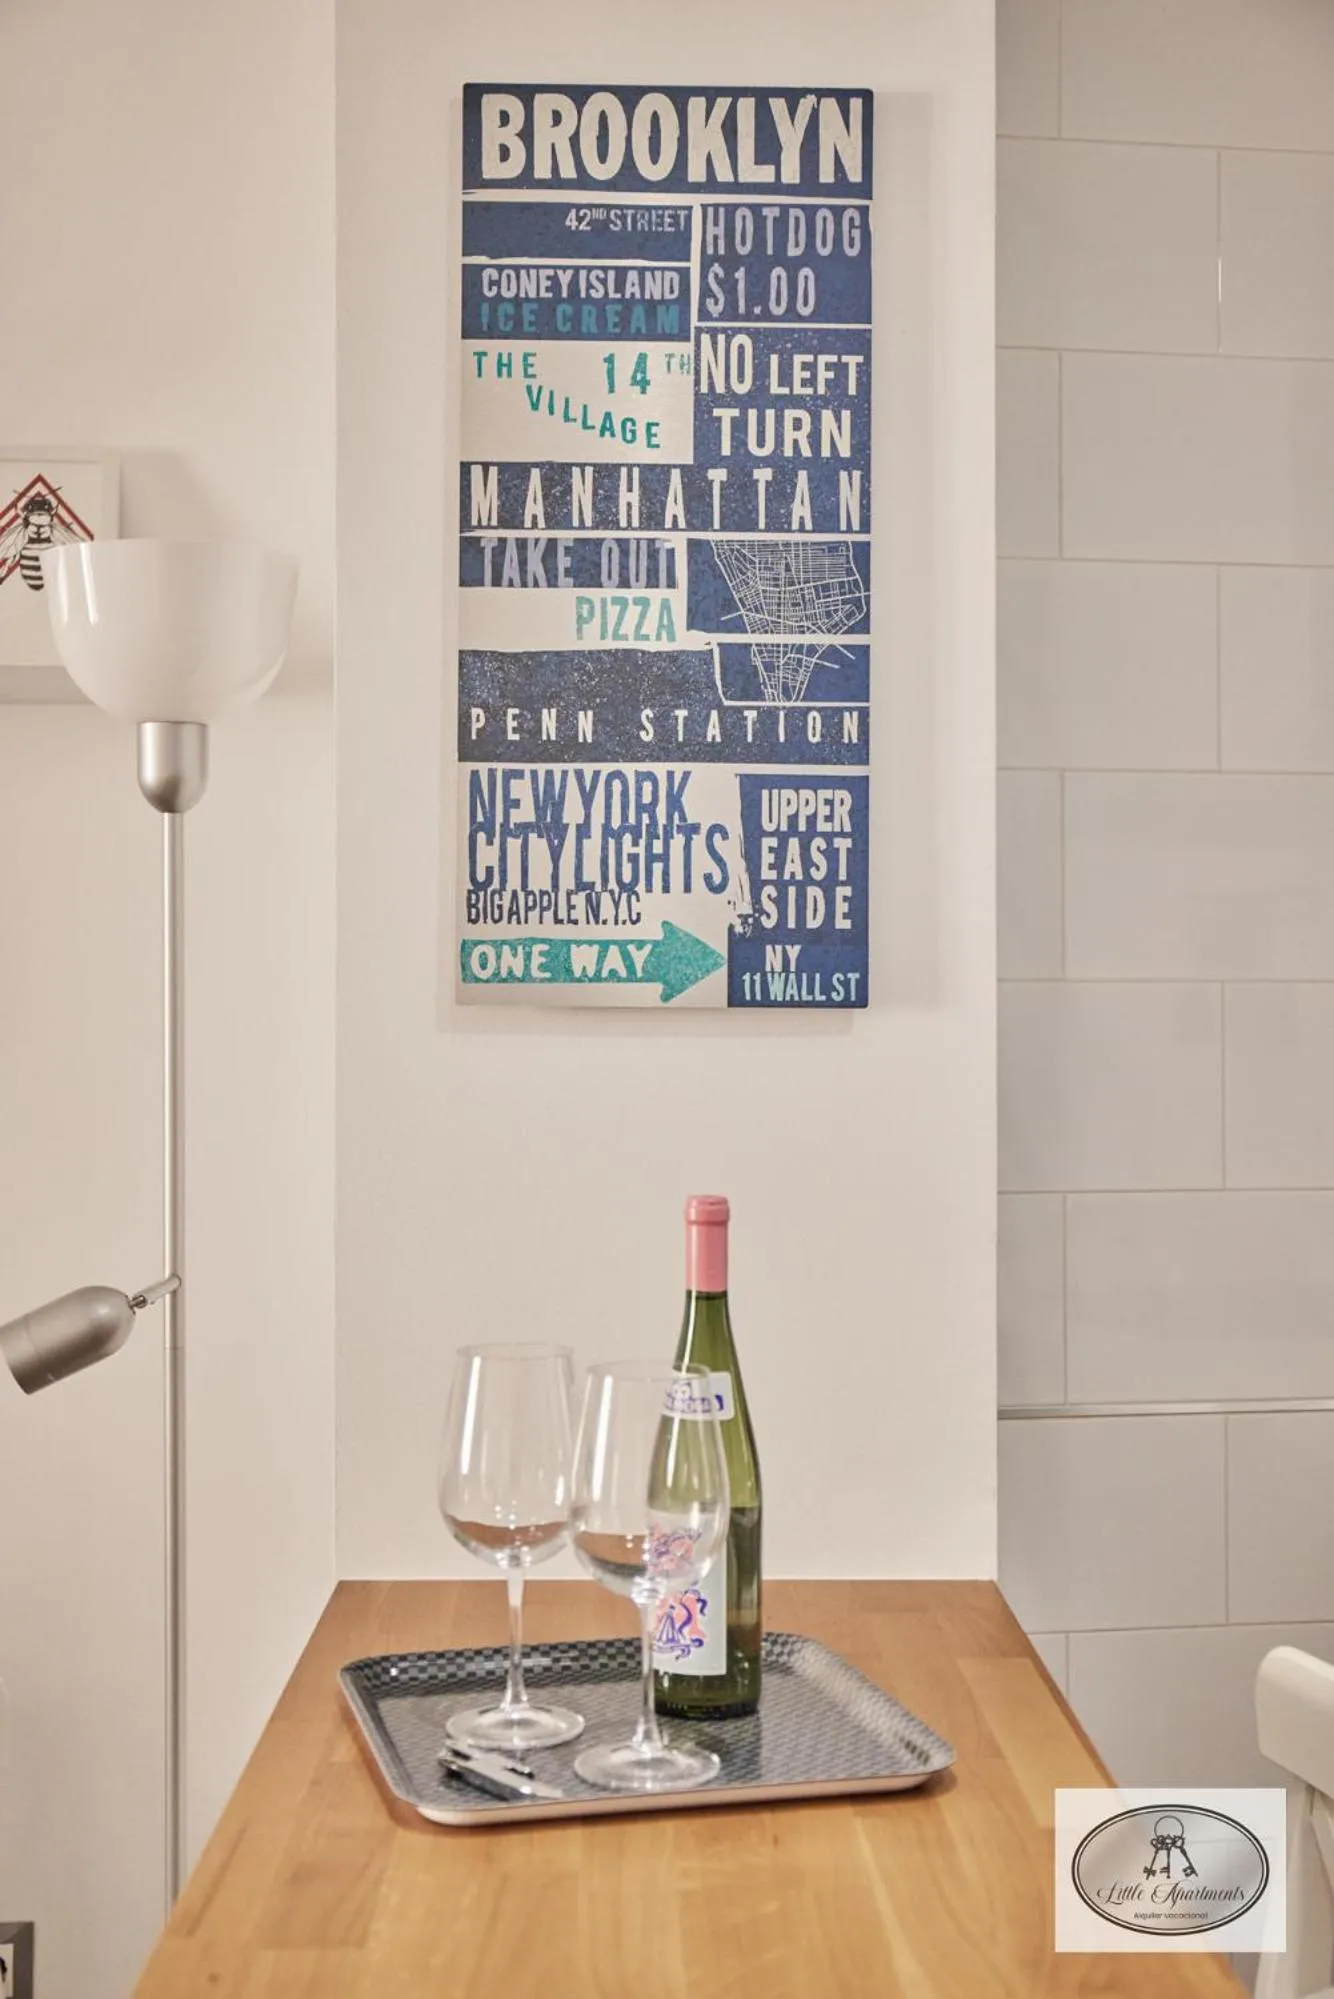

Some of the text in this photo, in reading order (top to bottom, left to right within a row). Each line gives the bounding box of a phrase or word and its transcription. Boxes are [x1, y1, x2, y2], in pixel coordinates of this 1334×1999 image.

[481, 92, 863, 184] BROOKLYN
[609, 209, 689, 233] STREET
[482, 268, 680, 300] CONEY ISLAND
[705, 263, 816, 317] $1.00
[480, 302, 680, 335] ICE CREAM
[473, 351, 538, 379] THE
[699, 333, 864, 395] NO LEFT
[526, 385, 661, 449] VILLAGE
[712, 408, 851, 458] TURN
[469, 464, 862, 531] MANHATTAN
[480, 538, 677, 588] TAKE OUT
[575, 595, 676, 642] PIZZA
[470, 708, 860, 744] PENN STATION
[761, 788, 852, 833] UPPER
[761, 838, 853, 881] EAST
[761, 886, 853, 930] SIDE
[469, 943, 653, 979] ONE WAY
[765, 944, 801, 972] NY
[766, 972, 828, 1002] WALL
[831, 972, 860, 1002] ST
